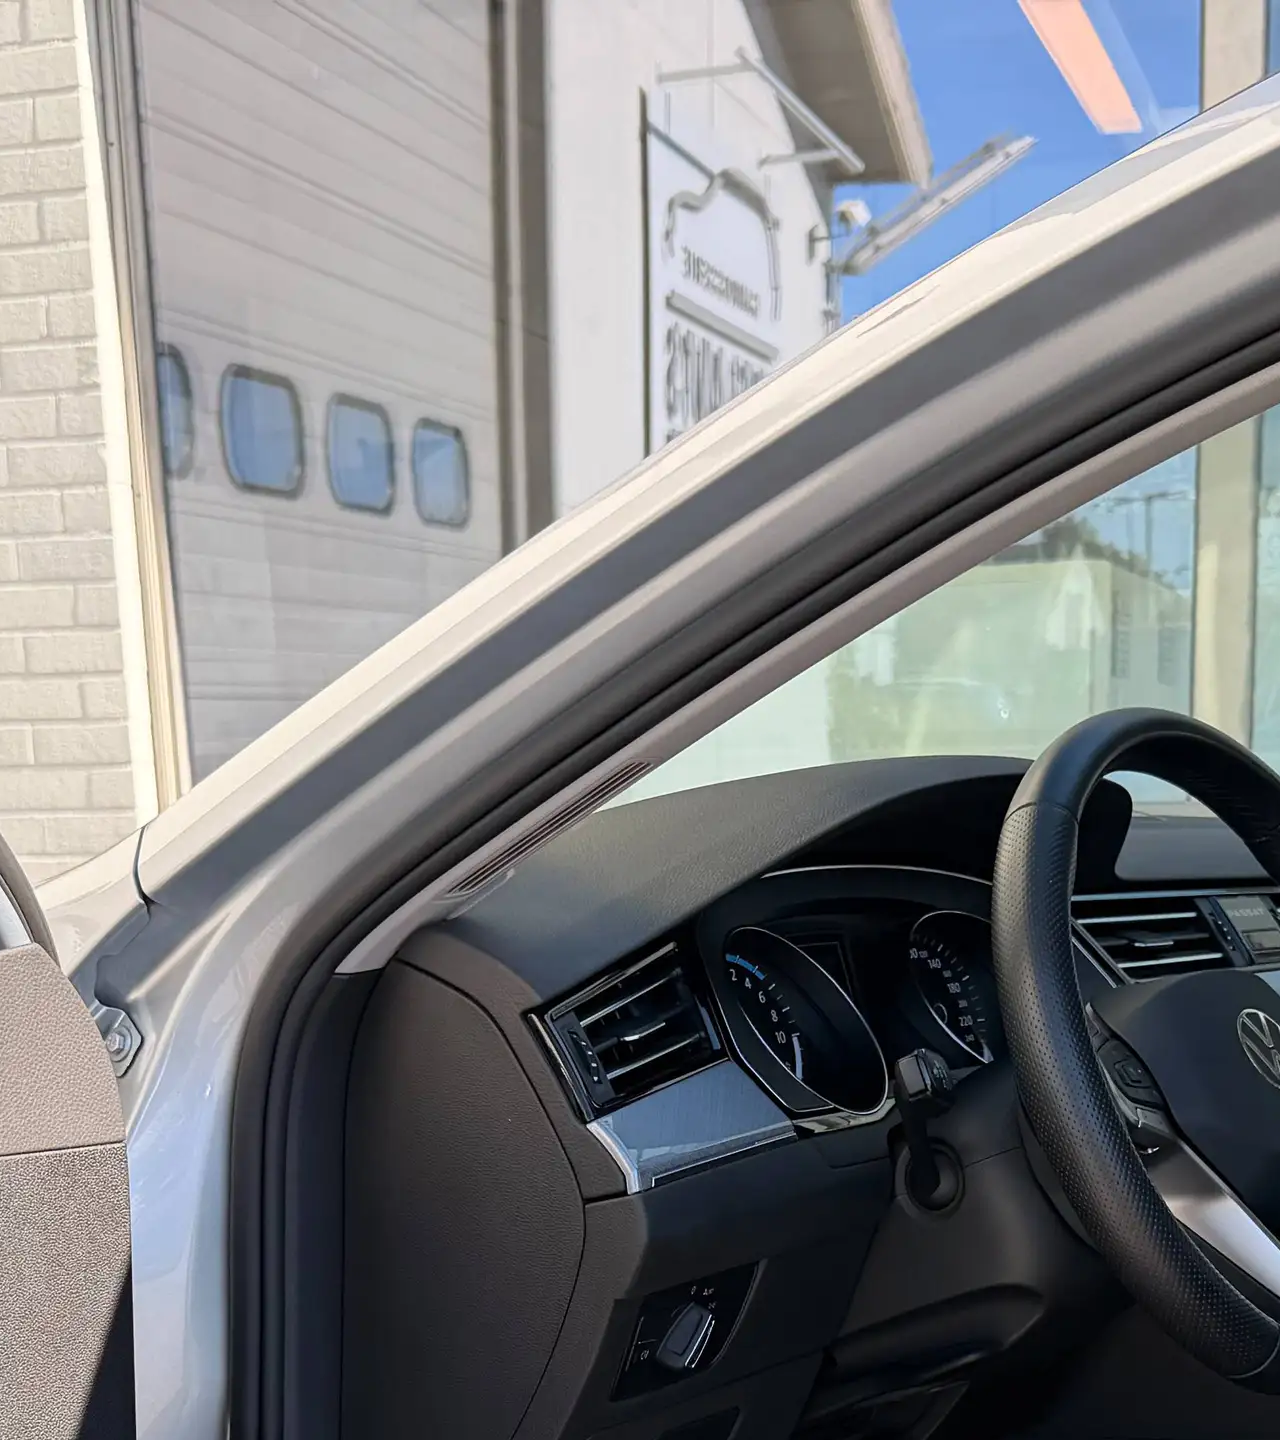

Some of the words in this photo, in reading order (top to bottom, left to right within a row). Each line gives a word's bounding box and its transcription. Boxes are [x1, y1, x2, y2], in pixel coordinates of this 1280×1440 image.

[927, 957, 942, 970] 140
[729, 968, 738, 982] 2
[744, 977, 752, 990] 4
[758, 990, 767, 1004] 6
[770, 1009, 779, 1023] 8
[958, 1014, 973, 1027] 220
[775, 1031, 787, 1044] 10
